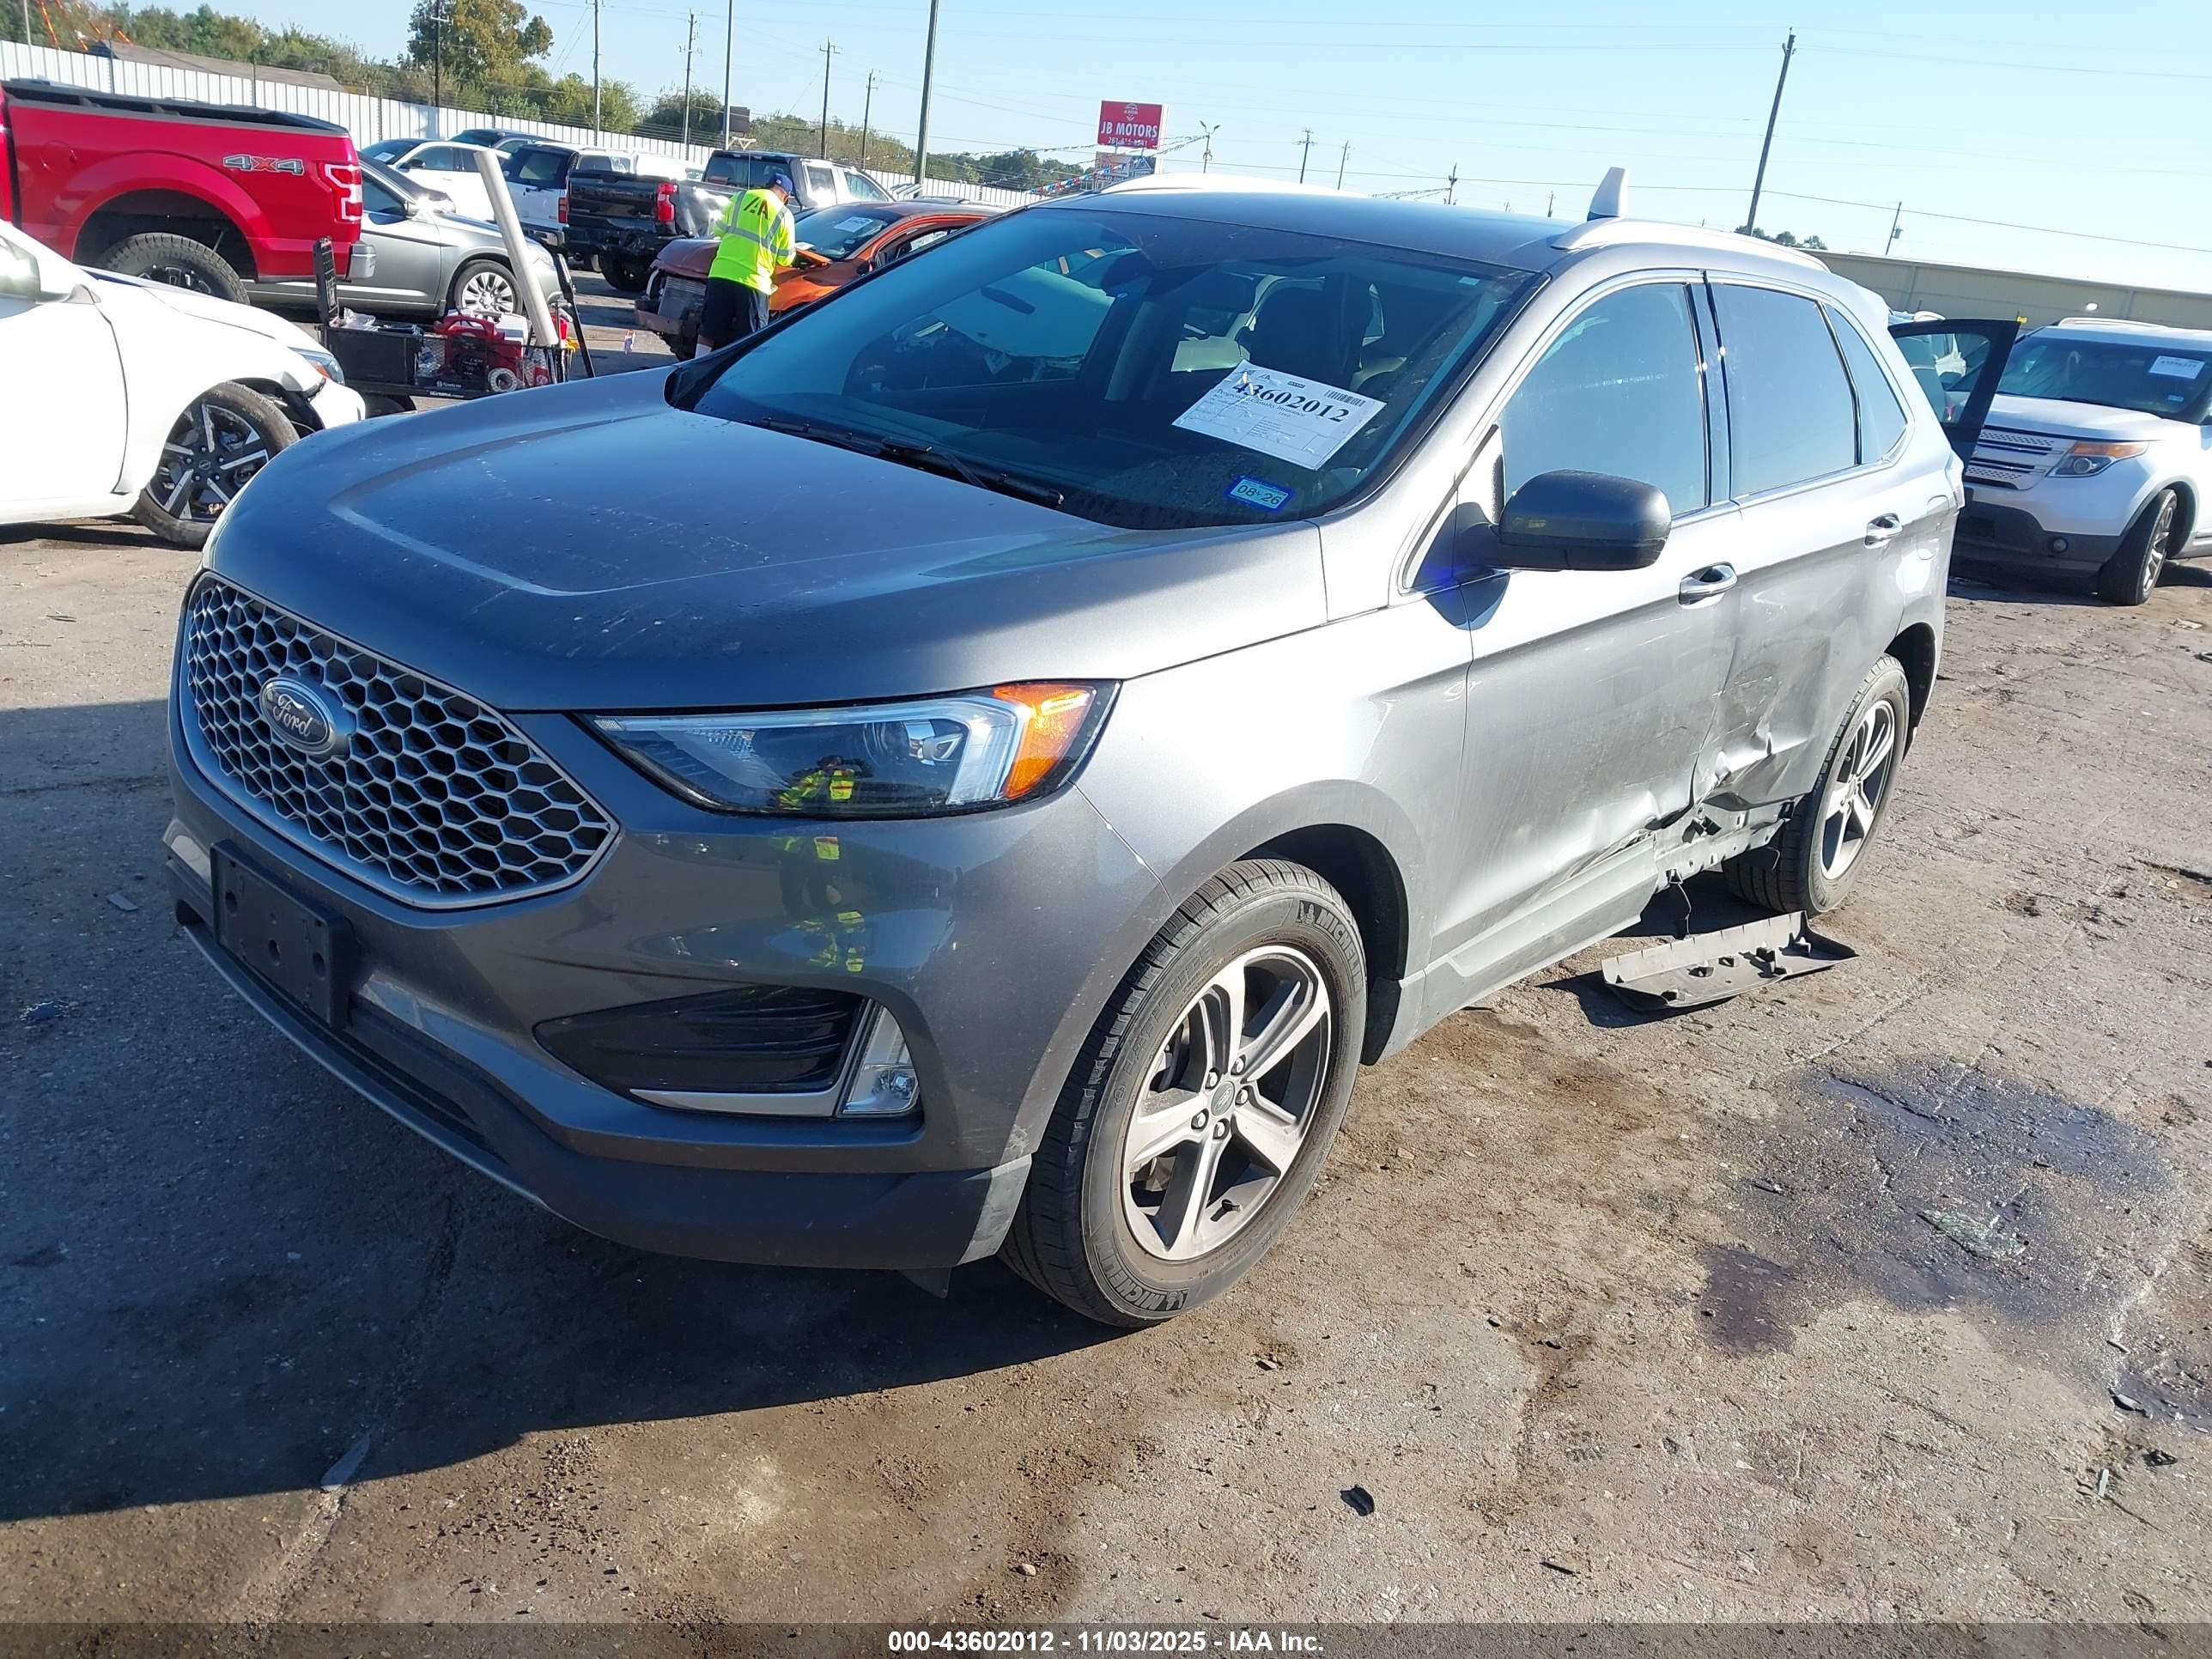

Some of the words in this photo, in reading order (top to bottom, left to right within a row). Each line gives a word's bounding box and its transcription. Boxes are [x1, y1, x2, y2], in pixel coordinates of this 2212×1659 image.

[1101, 121, 1113, 135] JB
[1115, 122, 1158, 138] MOTORS
[1232, 382, 1350, 422] 43602012
[272, 693, 313, 737] Ford
[1316, 908, 1364, 990] MICHELIN
[1096, 1239, 1166, 1311] MICHELIN
